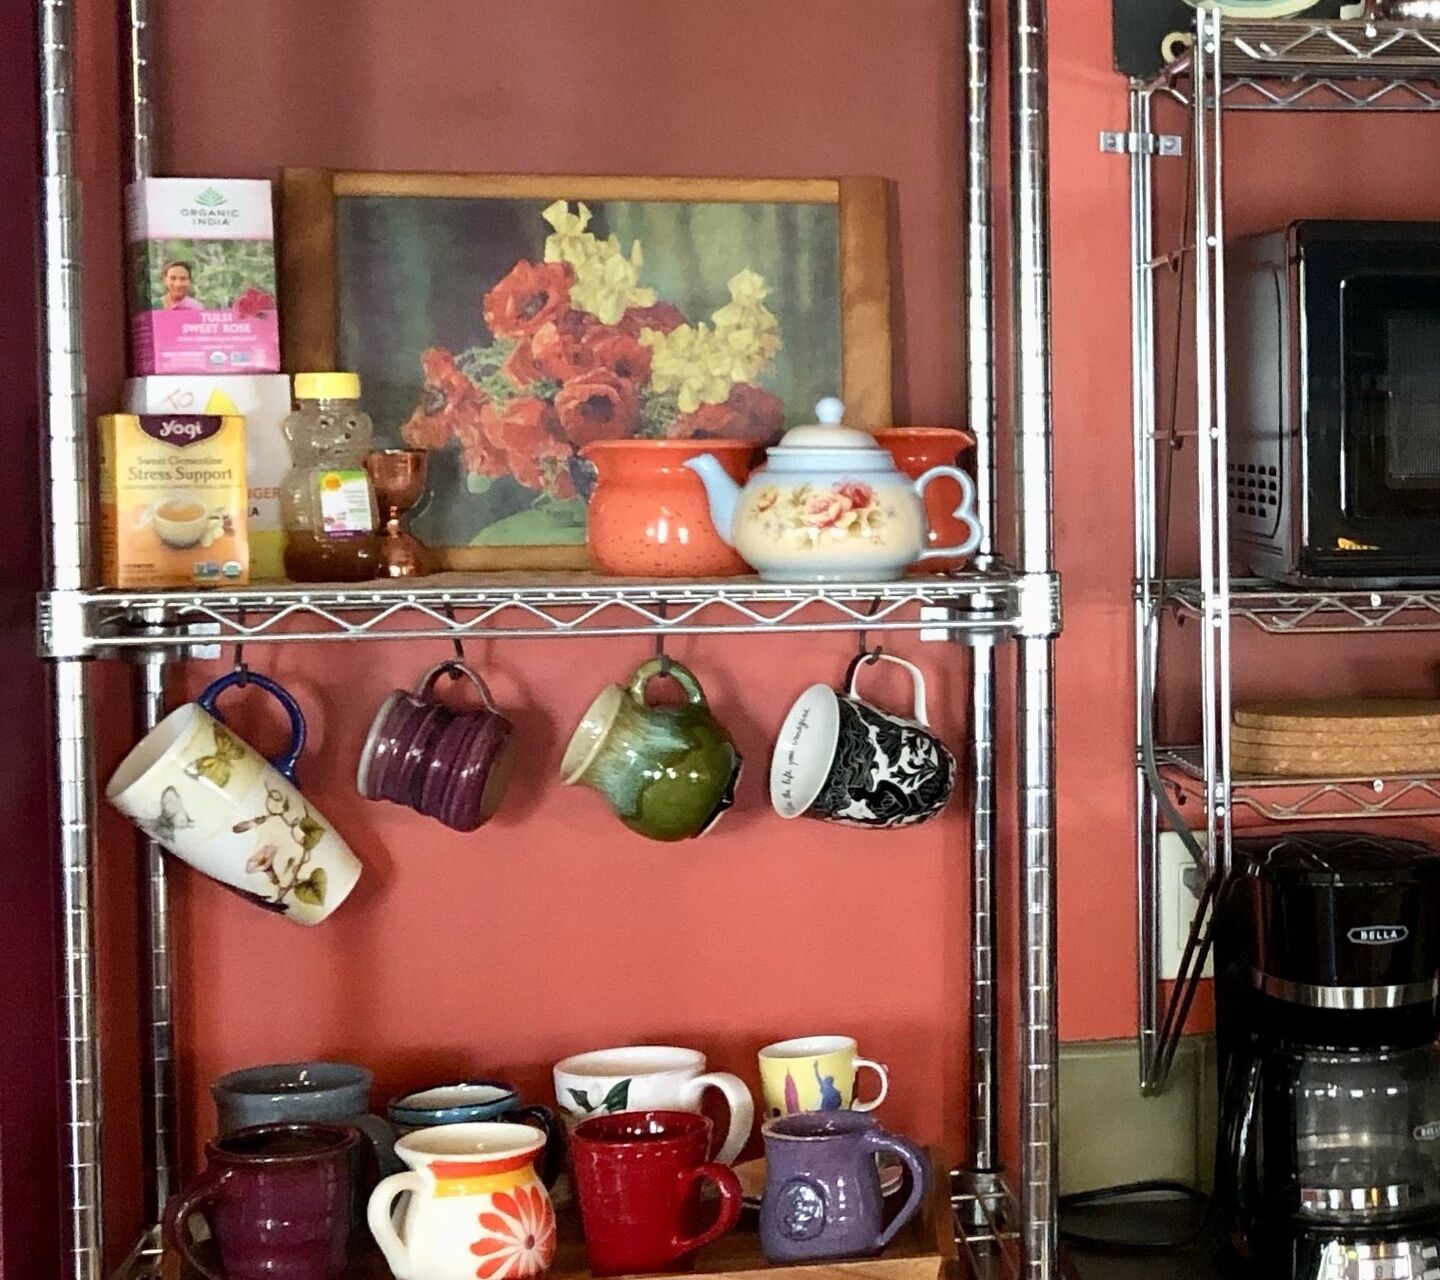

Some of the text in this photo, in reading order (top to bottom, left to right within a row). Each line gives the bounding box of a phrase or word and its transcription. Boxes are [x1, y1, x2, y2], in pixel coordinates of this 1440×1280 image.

[180, 208, 240, 218] ORGANIC
[160, 420, 203, 439] yogi
[128, 467, 233, 483] Stress Support
[1360, 930, 1398, 940] BELLA
